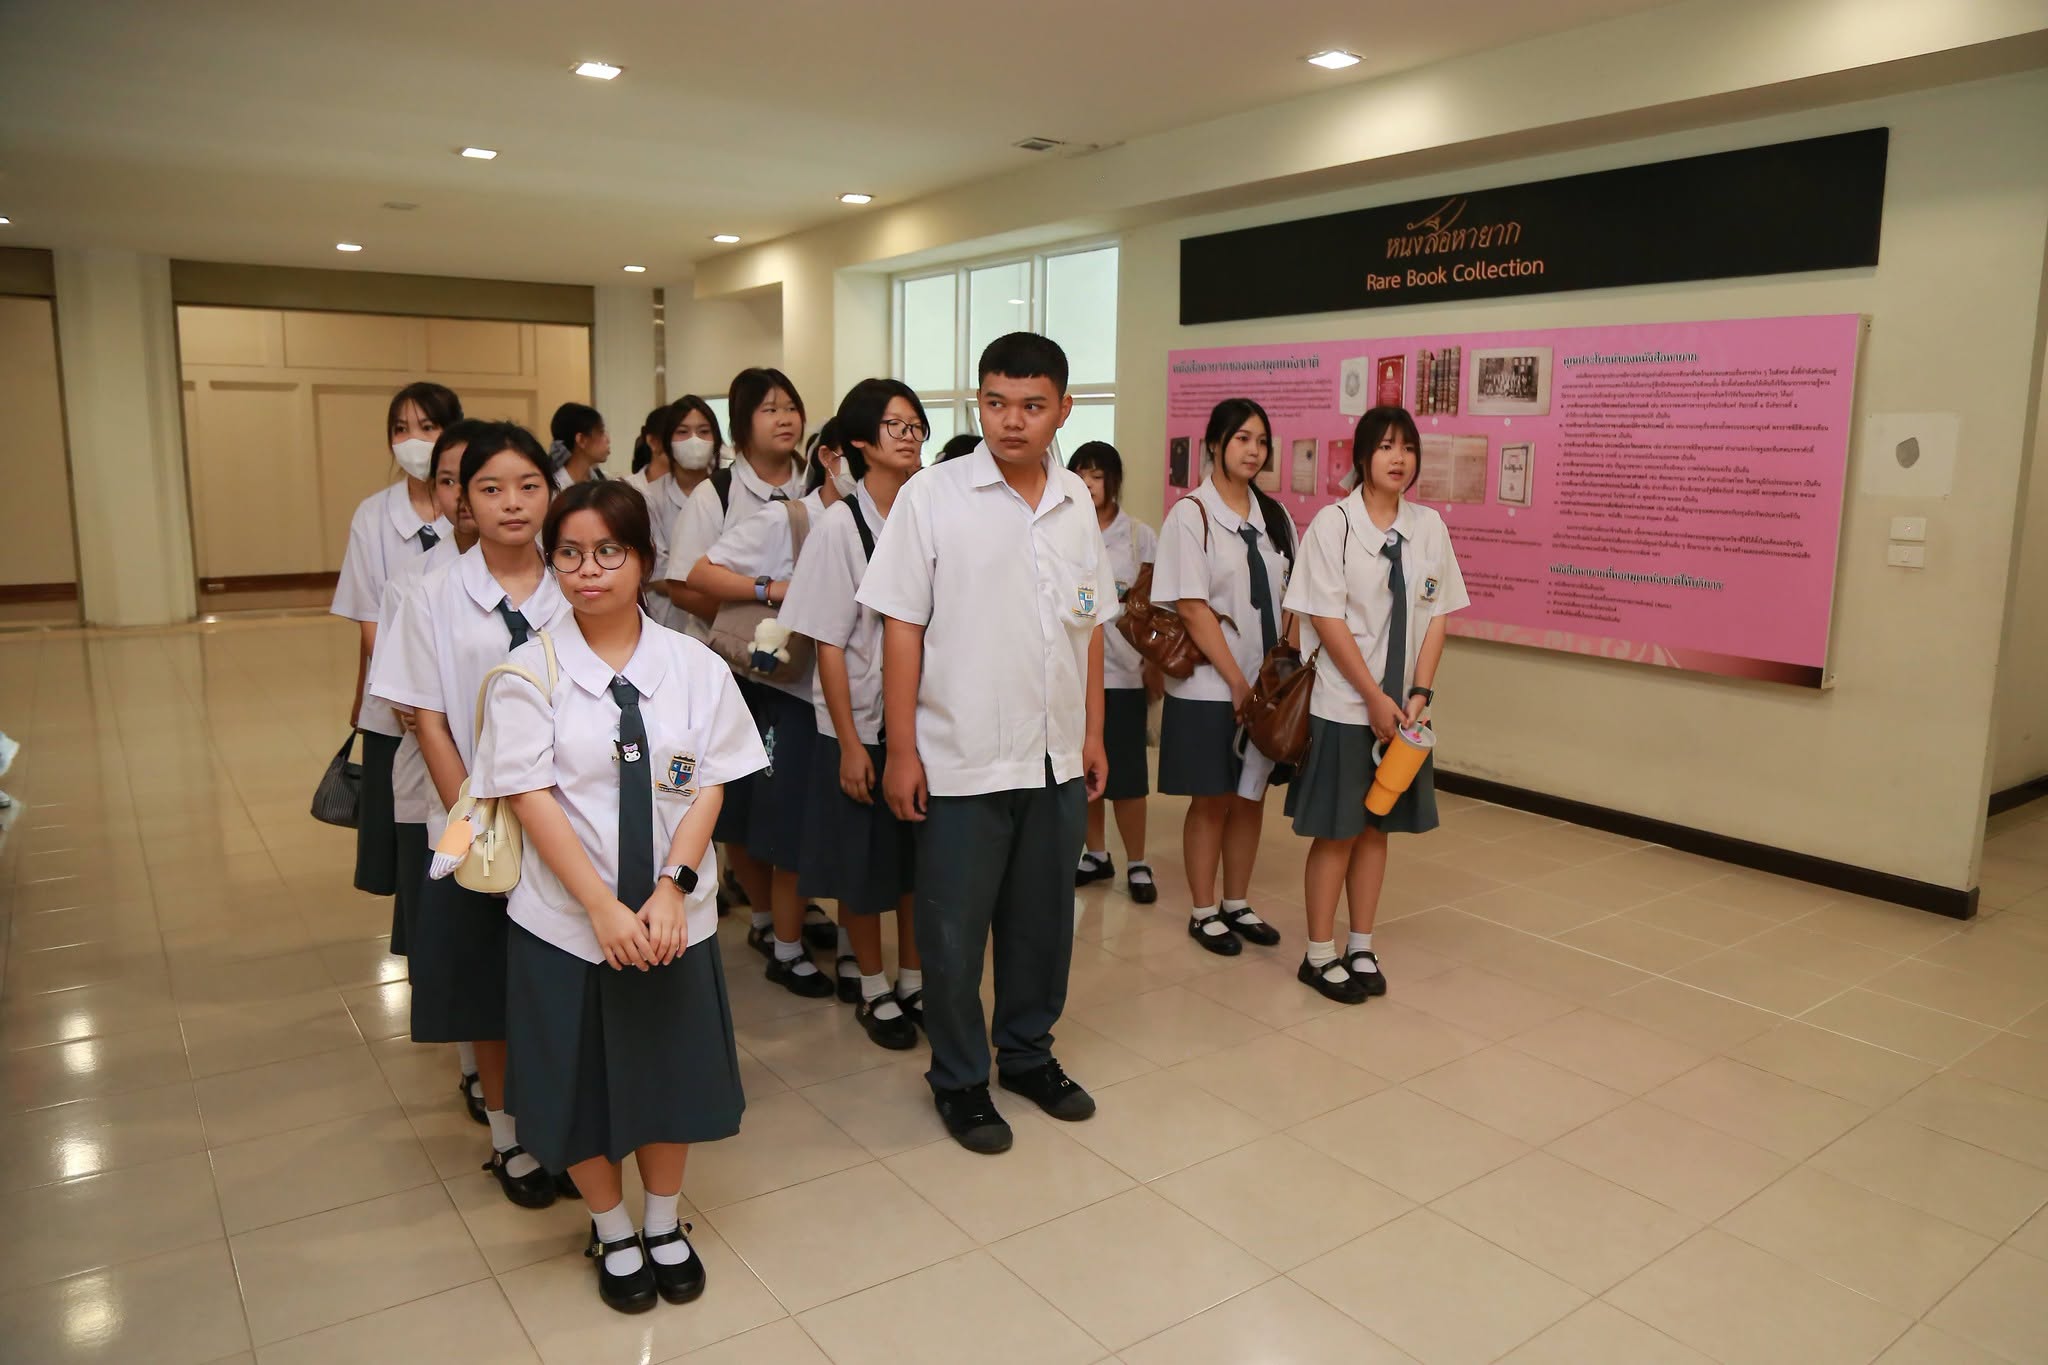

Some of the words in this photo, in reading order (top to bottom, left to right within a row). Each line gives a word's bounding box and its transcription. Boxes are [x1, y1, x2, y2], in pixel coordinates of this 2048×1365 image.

[1386, 197, 1521, 258] หนังสือหายาก
[1367, 273, 1401, 291] Rare
[1407, 266, 1447, 287] Book
[1452, 258, 1544, 282] Collection
